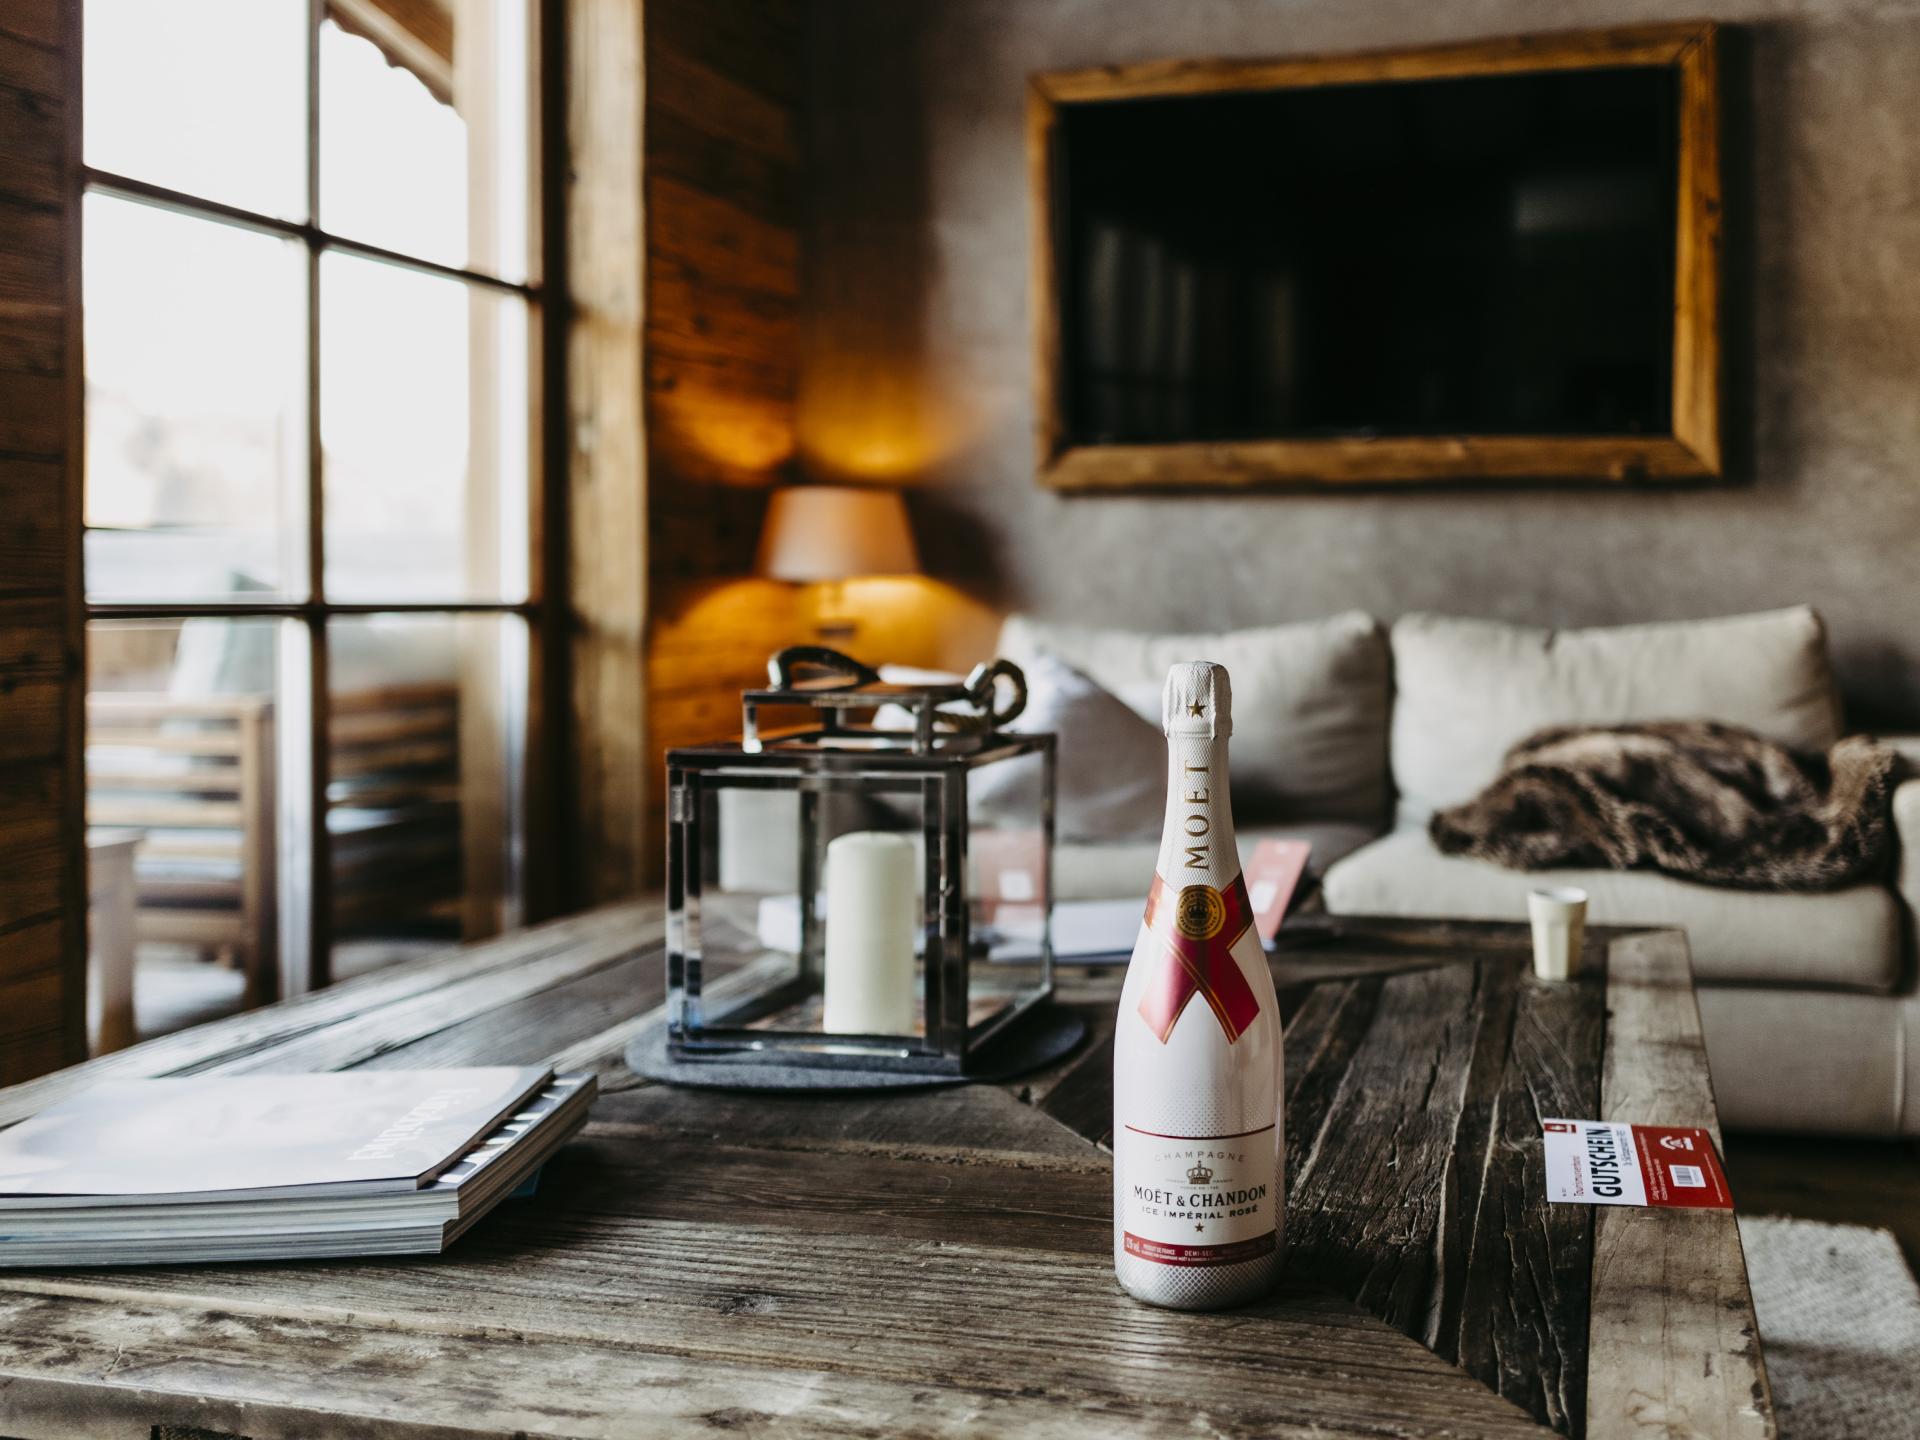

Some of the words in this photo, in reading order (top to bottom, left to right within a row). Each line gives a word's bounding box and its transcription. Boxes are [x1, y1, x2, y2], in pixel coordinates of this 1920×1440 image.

[1154, 1151, 1246, 1162] CHAMPAGNE
[1585, 1128, 1623, 1198] GUTSCHEIN
[1176, 1195, 1185, 1207] &
[1189, 1184, 1266, 1208] CHANDON
[1142, 1206, 1159, 1217] ICE
[1164, 1208, 1224, 1219] IMPÉRIAL
